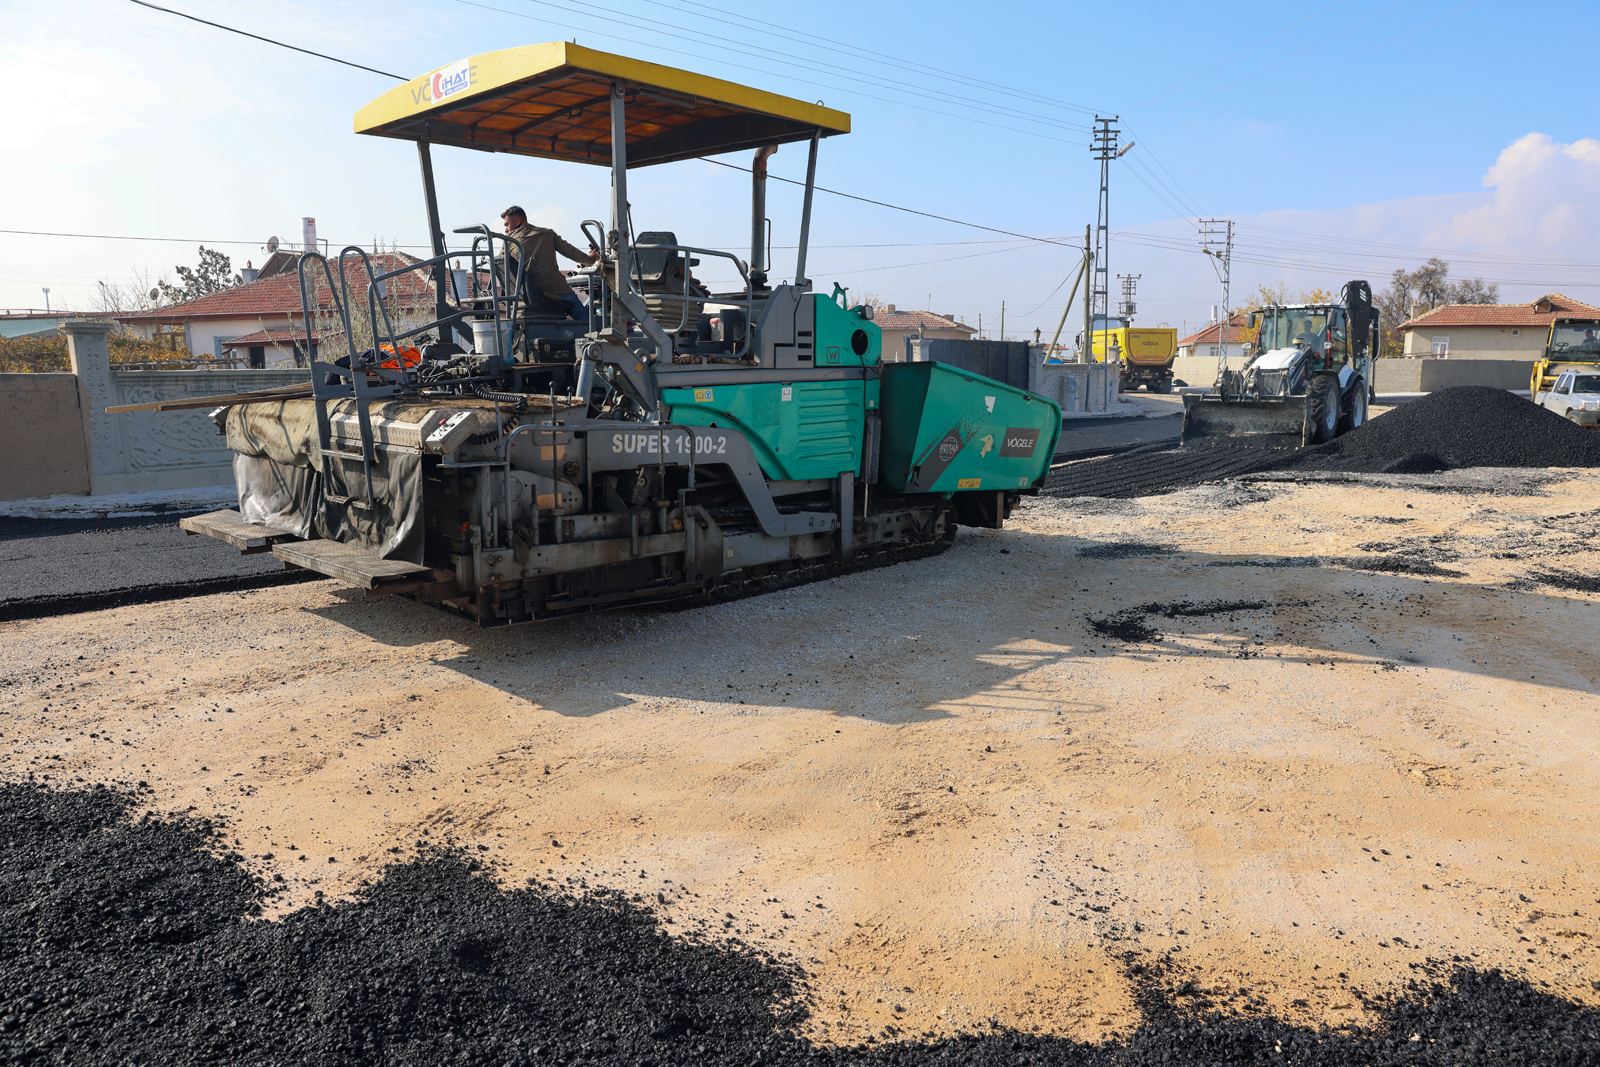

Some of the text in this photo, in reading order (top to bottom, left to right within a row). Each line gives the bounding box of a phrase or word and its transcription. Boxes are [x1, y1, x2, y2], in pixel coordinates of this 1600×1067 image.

[611, 434, 727, 454] SUPER 1900-2
[1007, 436, 1034, 448] VÖGELE
